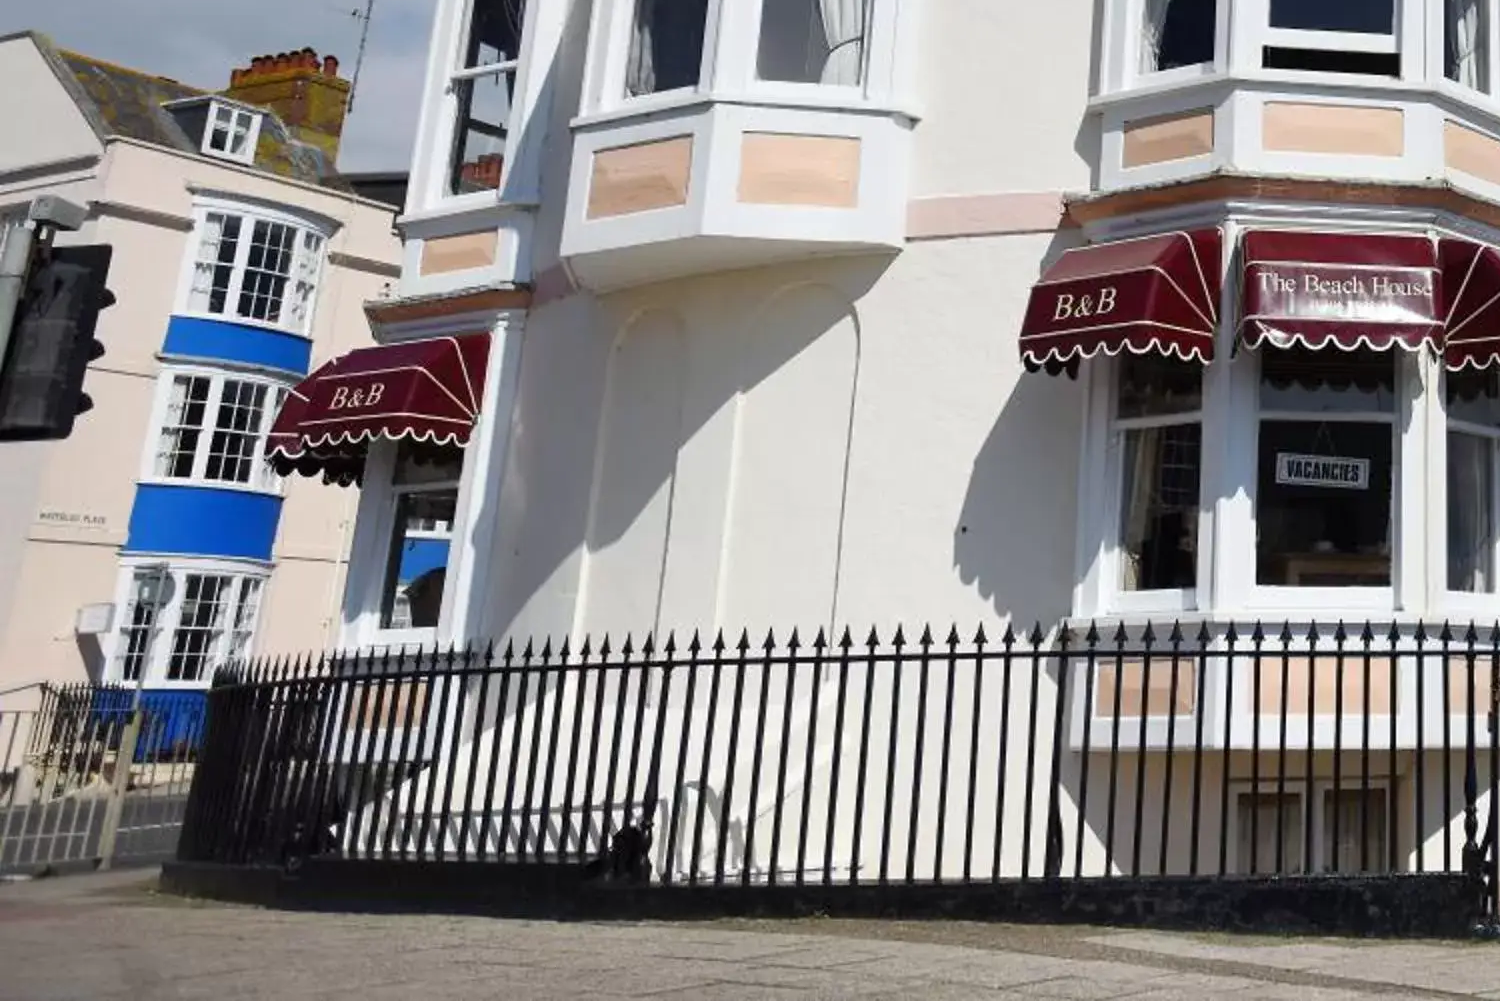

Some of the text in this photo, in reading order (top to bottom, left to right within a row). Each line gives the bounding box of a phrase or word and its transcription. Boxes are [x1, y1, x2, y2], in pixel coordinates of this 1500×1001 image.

[1257, 272, 1433, 296] The Beach House
[1053, 286, 1118, 321] B&B
[328, 382, 385, 410] B&B
[1286, 460, 1360, 483] VACANCIES
